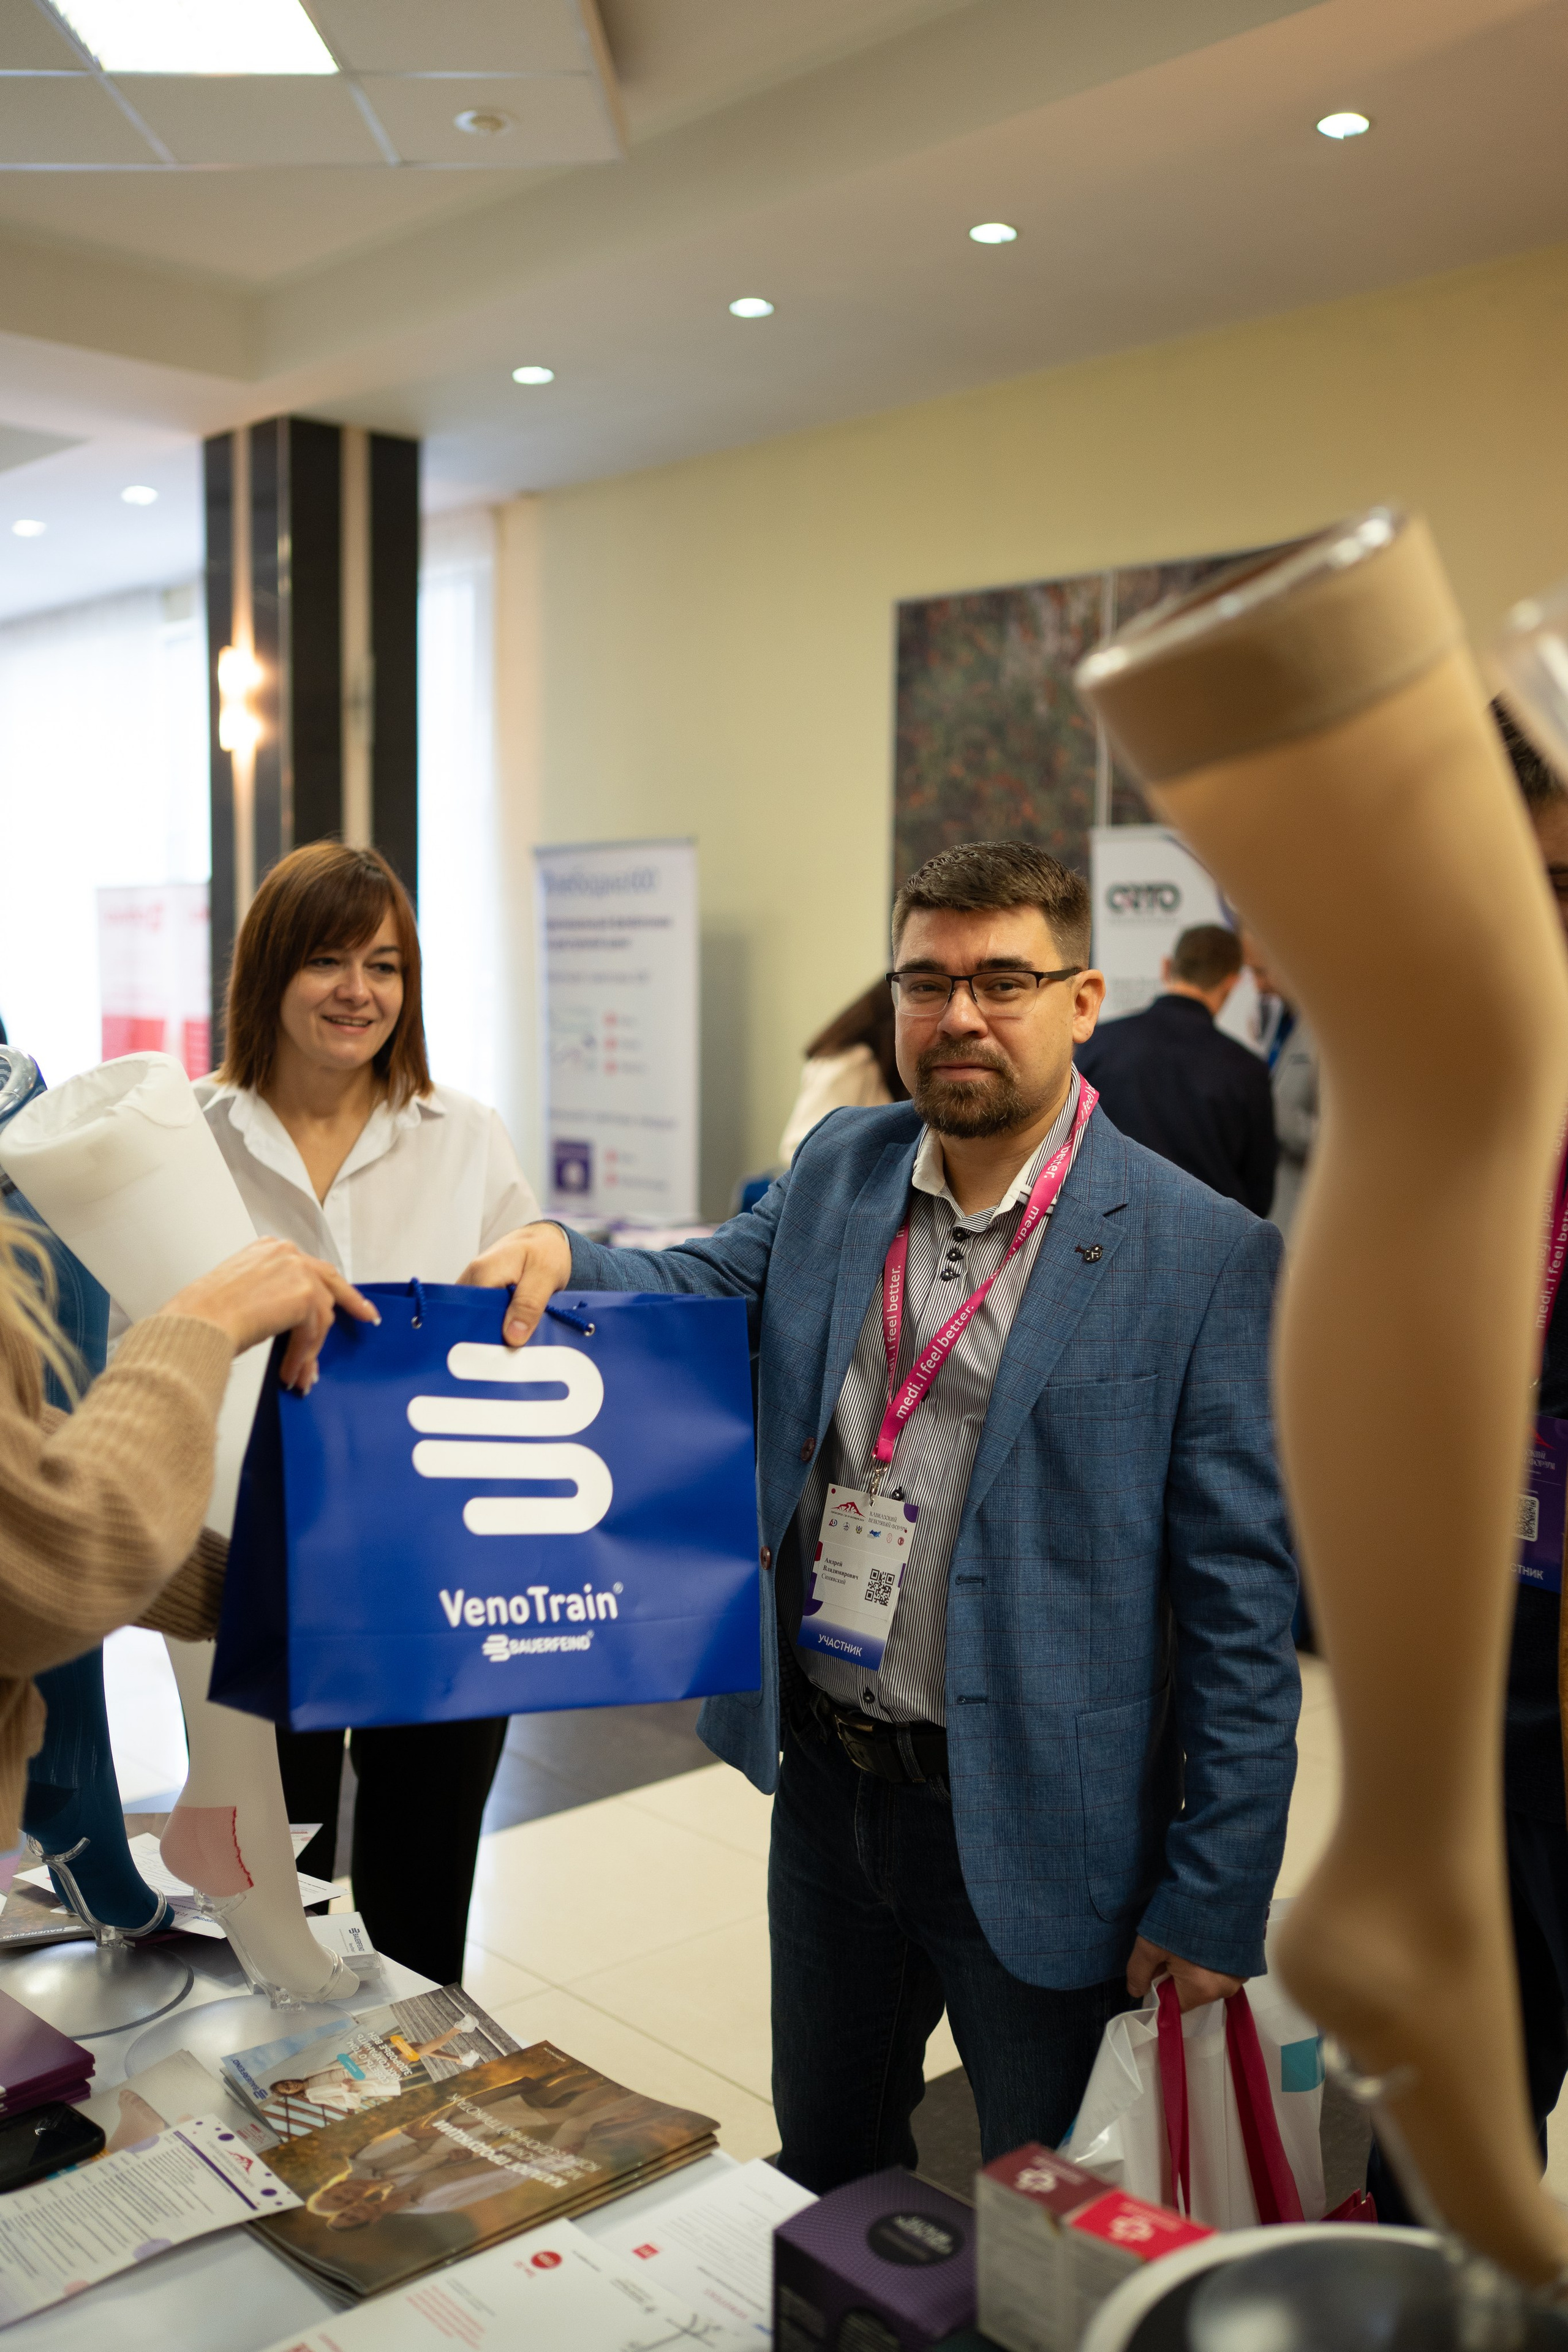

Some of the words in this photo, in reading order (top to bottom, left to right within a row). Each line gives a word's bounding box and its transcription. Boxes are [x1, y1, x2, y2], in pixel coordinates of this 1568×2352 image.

[1083, 1090, 1095, 1115] feel
[1044, 1145, 1072, 1178] better.
[1547, 1246, 1564, 1274] feel
[887, 1265, 901, 1312] better.
[887, 1315, 897, 1343] feel
[896, 1382, 923, 1419] medi.
[920, 1346, 943, 1374] feel
[937, 1305, 974, 1348] better.
[870, 1511, 897, 1522] КАВКАЗСКИЙ
[823, 1565, 859, 1580] Владимирович
[824, 1558, 843, 1567] Андрей
[1510, 1562, 1544, 1580] СТНИК
[821, 1573, 846, 1585] Синявский
[818, 1634, 862, 1657] УЧАСТНИК
[3, 1928, 62, 1939] BAUERFEIND
[357, 2034, 390, 2068] СОХРАНИТЬ
[368, 2032, 383, 2045] ВЕН
[379, 2044, 413, 2076] ЗДОРОВЬЕ
[233, 2059, 260, 2091] BAUERFEIND
